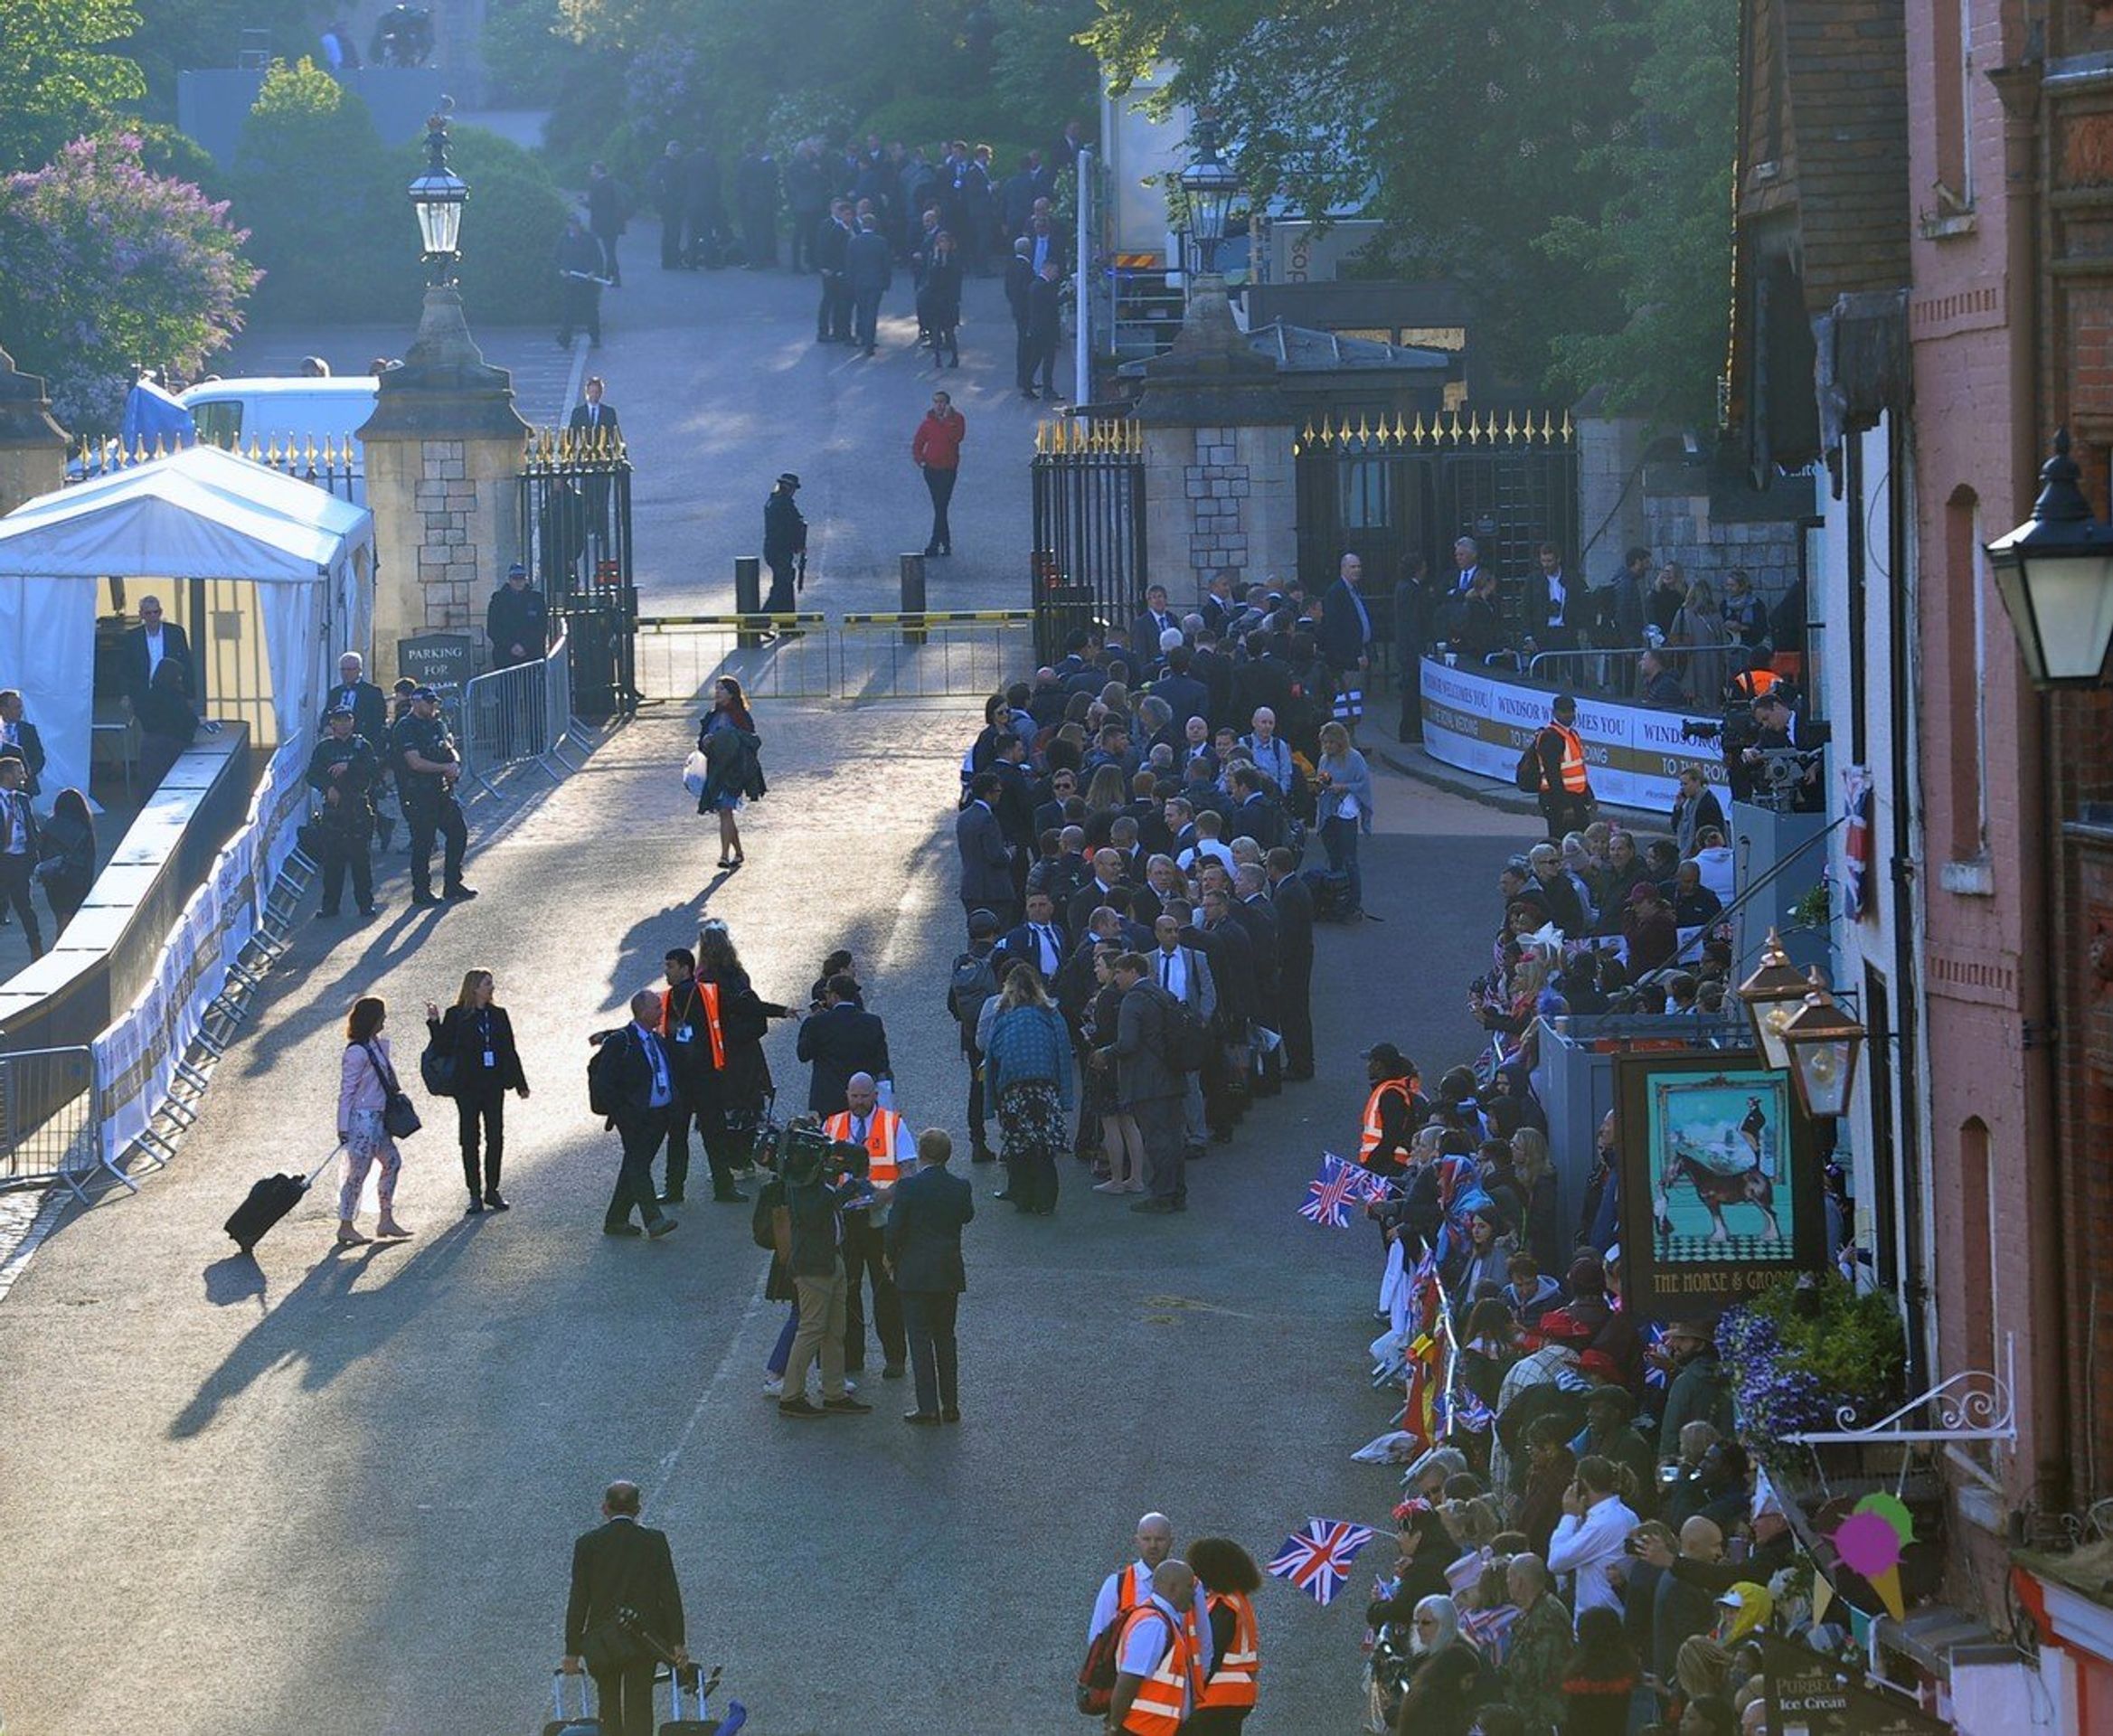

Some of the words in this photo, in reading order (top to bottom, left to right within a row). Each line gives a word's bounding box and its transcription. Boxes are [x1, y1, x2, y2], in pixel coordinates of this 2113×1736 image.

[409, 647, 462, 660] PARKING
[424, 665, 448, 675] FOR
[1498, 696, 1541, 721] WINDSOR
[1599, 717, 1626, 736] YOU
[1510, 730, 1521, 746] TO
[1662, 758, 1677, 775] TO
[1653, 1273, 1679, 1293] THE
[1683, 1272, 1728, 1291] HORSE
[1731, 1271, 1743, 1291] &
[1780, 1698, 1801, 1711] Ice
